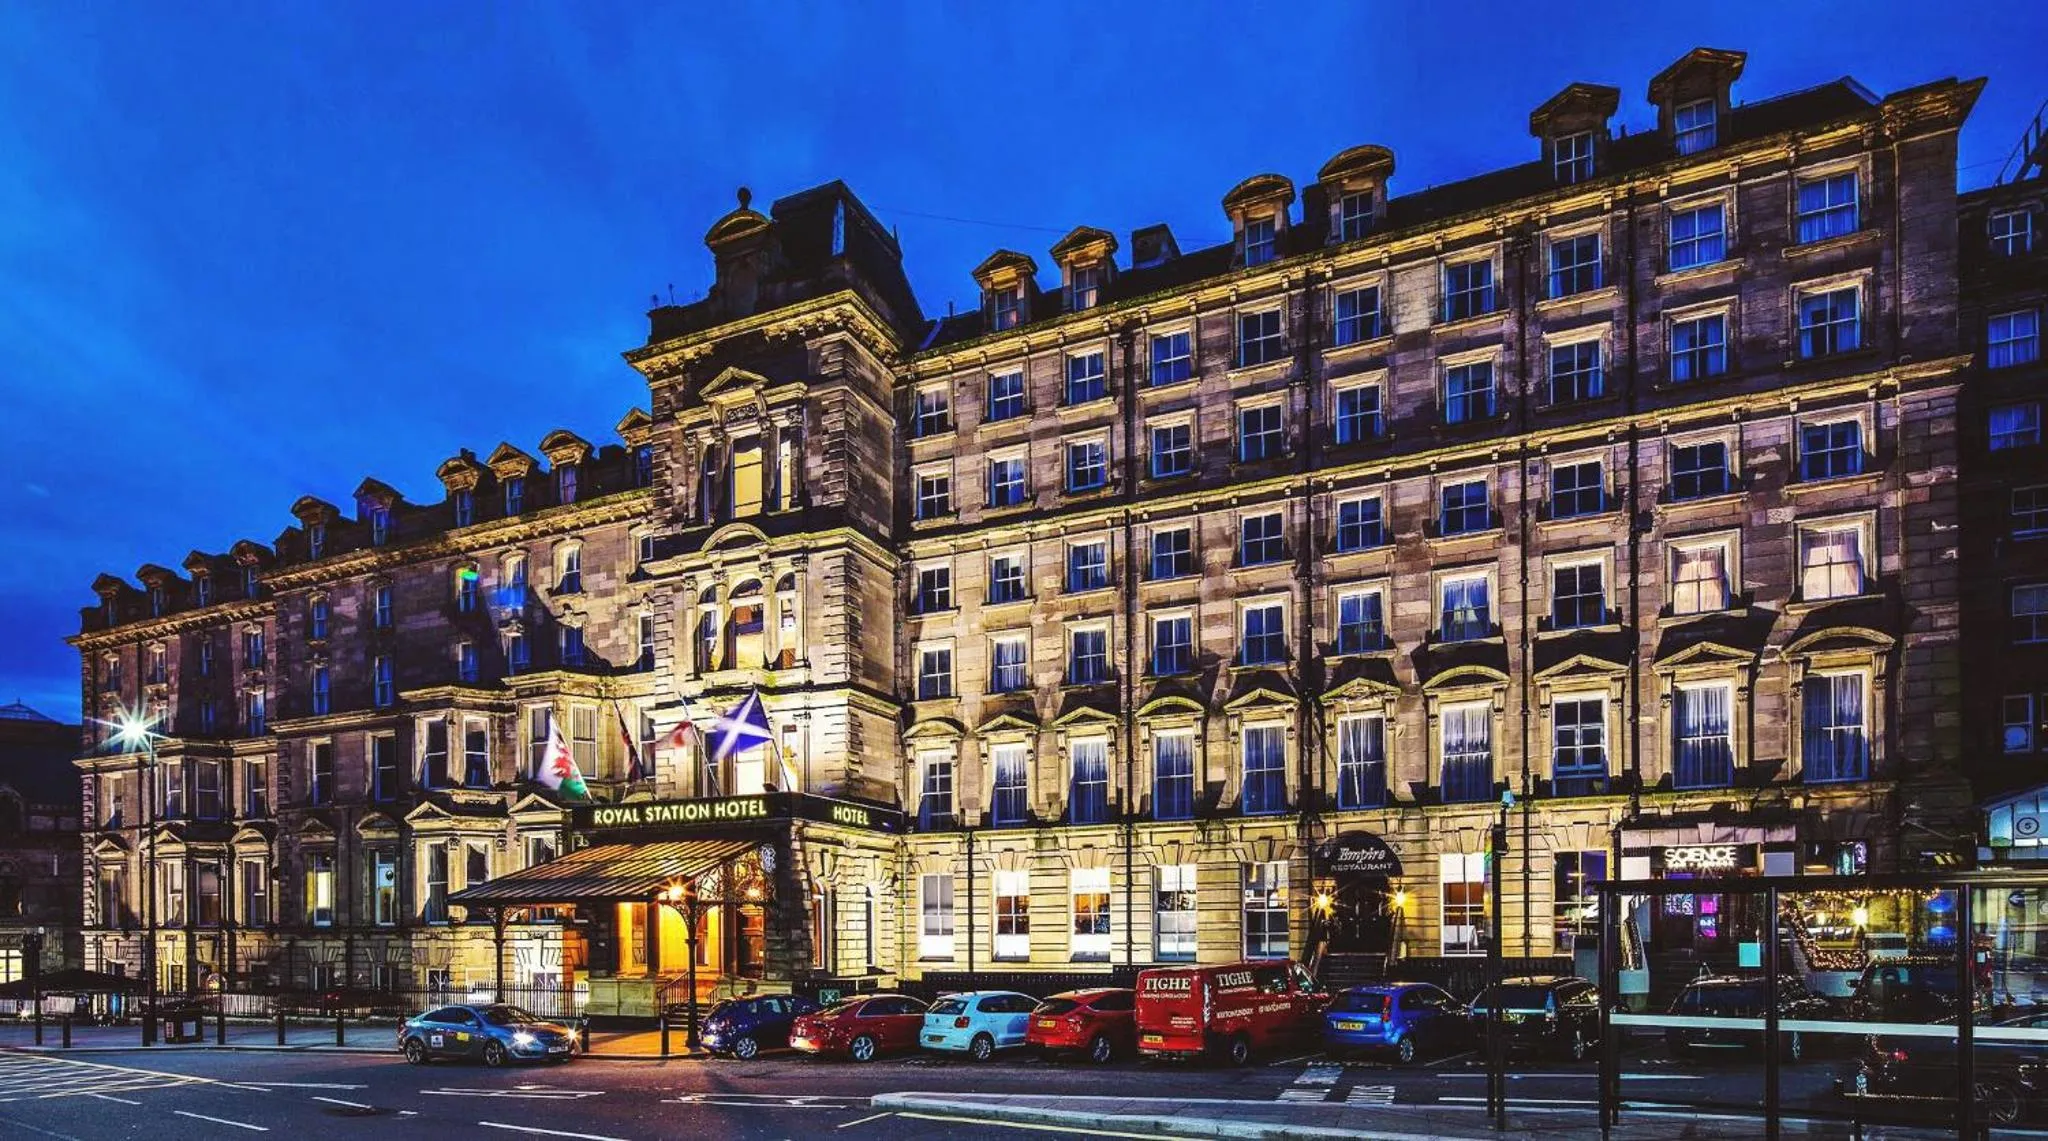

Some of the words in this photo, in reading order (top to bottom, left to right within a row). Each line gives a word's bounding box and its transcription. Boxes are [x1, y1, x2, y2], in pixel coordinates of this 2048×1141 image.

[594, 807, 640, 825] ROYAL
[645, 803, 709, 822] STATION
[715, 799, 767, 818] HOTEL
[833, 806, 869, 825] HOTEL
[1337, 847, 1386, 864] Empire
[1665, 846, 1737, 862] SCIENCE
[1331, 862, 1393, 872] RESTAURANT
[1144, 978, 1191, 990] TIGHE
[1216, 971, 1254, 987] TIGHE
